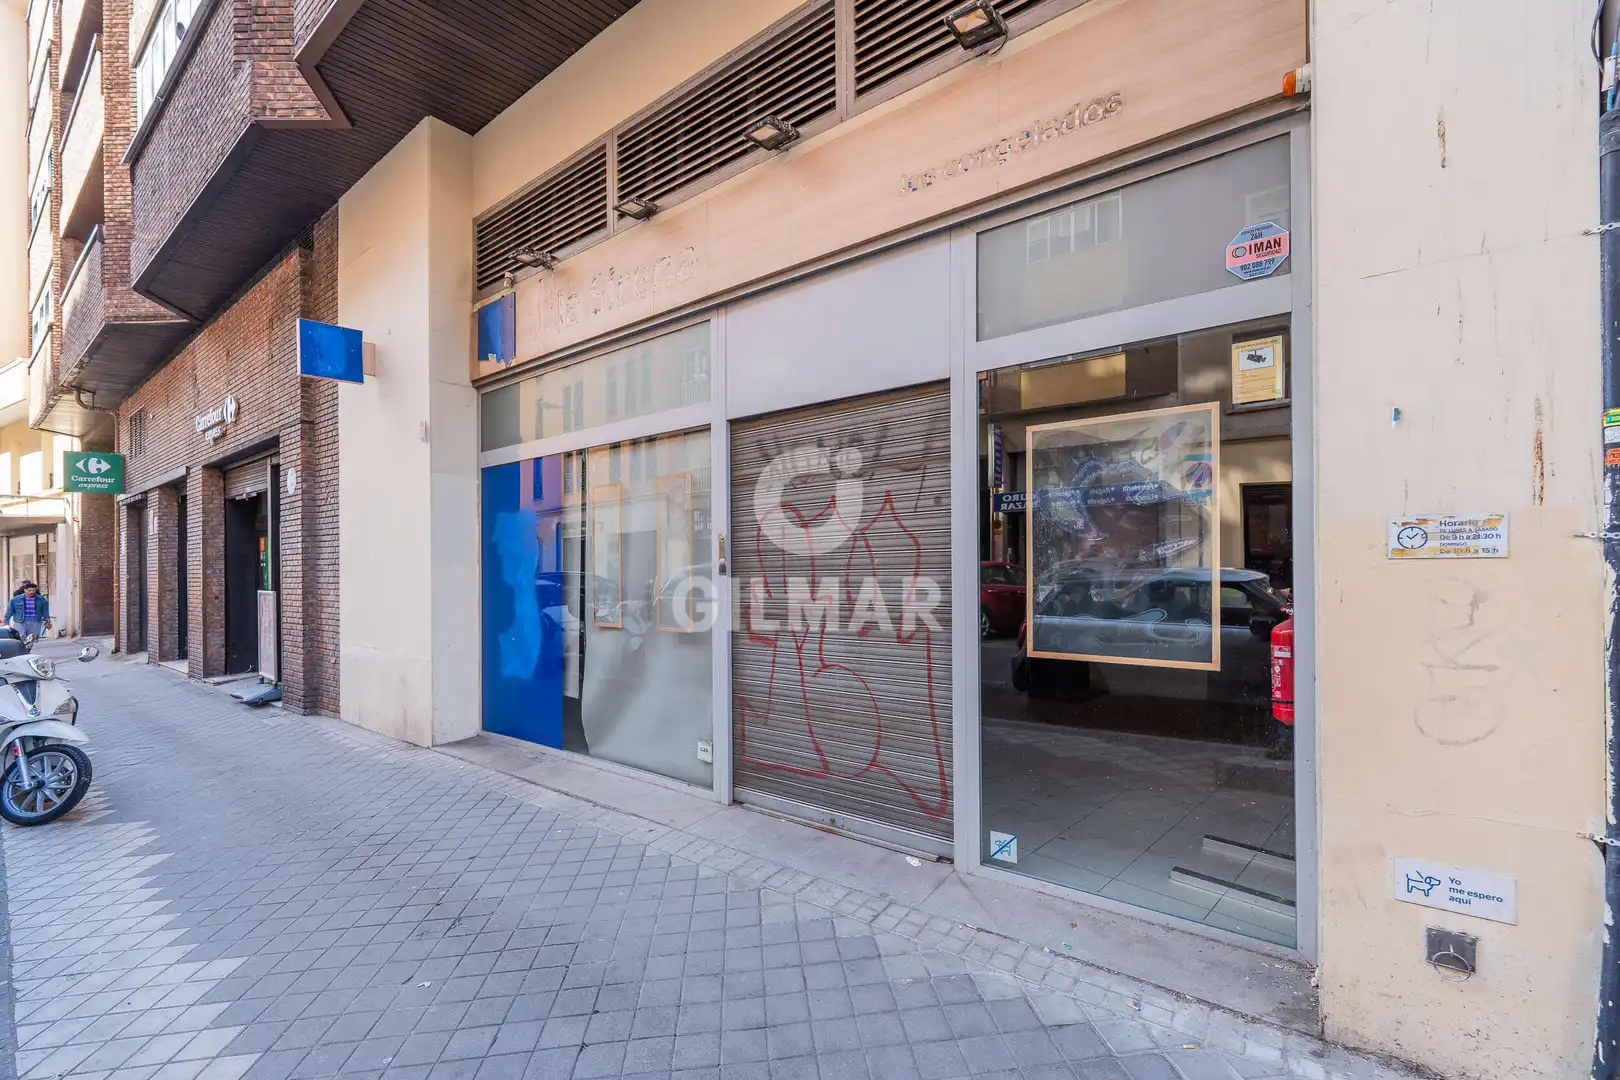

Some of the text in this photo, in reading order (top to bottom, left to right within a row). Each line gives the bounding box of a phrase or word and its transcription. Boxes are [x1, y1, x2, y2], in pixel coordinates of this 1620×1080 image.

[943, 92, 1123, 178] congelados
[1250, 232, 1263, 241] 24H
[1249, 238, 1281, 255] IMAN
[1240, 262, 1251, 271] 902
[71, 475, 115, 483] Carrefour
[1440, 518, 1478, 527] Horario
[1448, 876, 1462, 886] Yo
[1448, 886, 1503, 903] me espero
[1448, 895, 1472, 905] aquí
